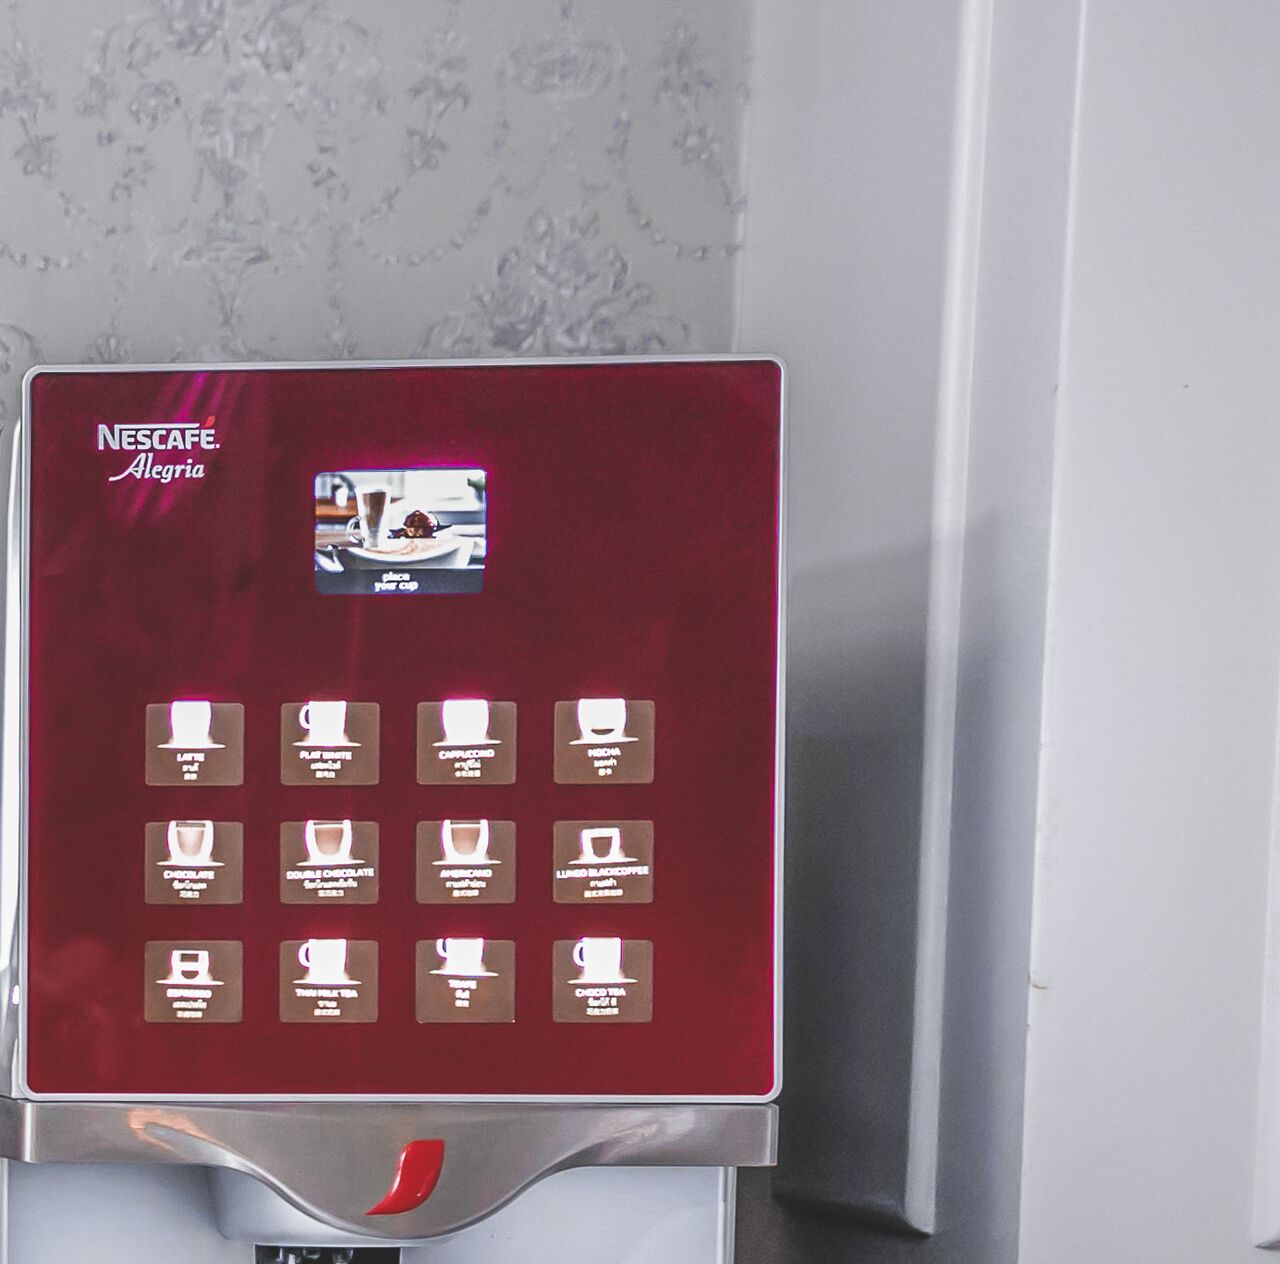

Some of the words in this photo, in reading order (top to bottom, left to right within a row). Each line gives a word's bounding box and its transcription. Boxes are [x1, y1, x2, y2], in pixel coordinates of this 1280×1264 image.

[97, 415, 216, 450] NESCAFÉ
[108, 452, 206, 483] Alegria
[374, 581, 398, 592] your
[399, 581, 419, 592] cup
[176, 752, 206, 762] LATTE
[299, 750, 322, 760] FLAT
[322, 751, 353, 760] WHITE
[438, 748, 496, 760] CAPPUCCINO
[587, 747, 622, 758] MOCHA
[163, 870, 215, 880] CHOCOLATE
[286, 869, 323, 880] DOUBLE
[323, 867, 375, 878] CHOCOLATE
[439, 868, 493, 879] AMERICANO
[339, 988, 358, 999] TEA
[574, 987, 607, 998] CHOCO
[607, 987, 627, 998] TEA
